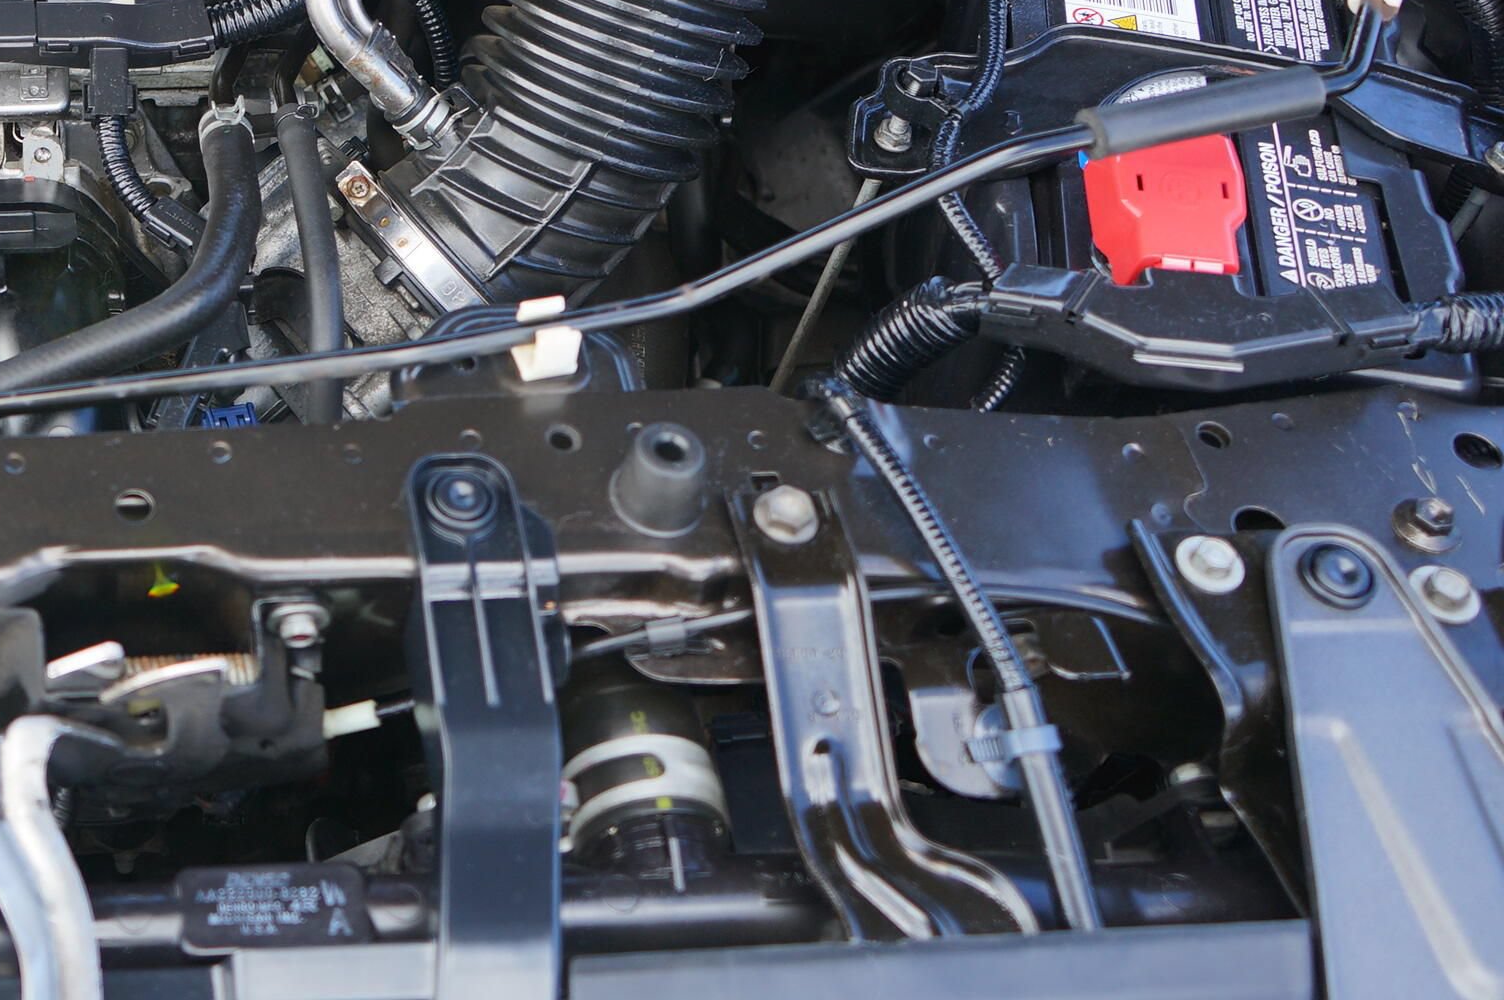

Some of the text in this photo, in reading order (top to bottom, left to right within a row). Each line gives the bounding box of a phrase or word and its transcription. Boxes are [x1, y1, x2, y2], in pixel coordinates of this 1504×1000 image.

[1258, 7, 1270, 23] EYES
[1258, 142, 1283, 194] POISON
[1270, 207, 1296, 268] DANGER
[1305, 238, 1320, 267] SHIELD
[1318, 248, 1331, 268] EYES
